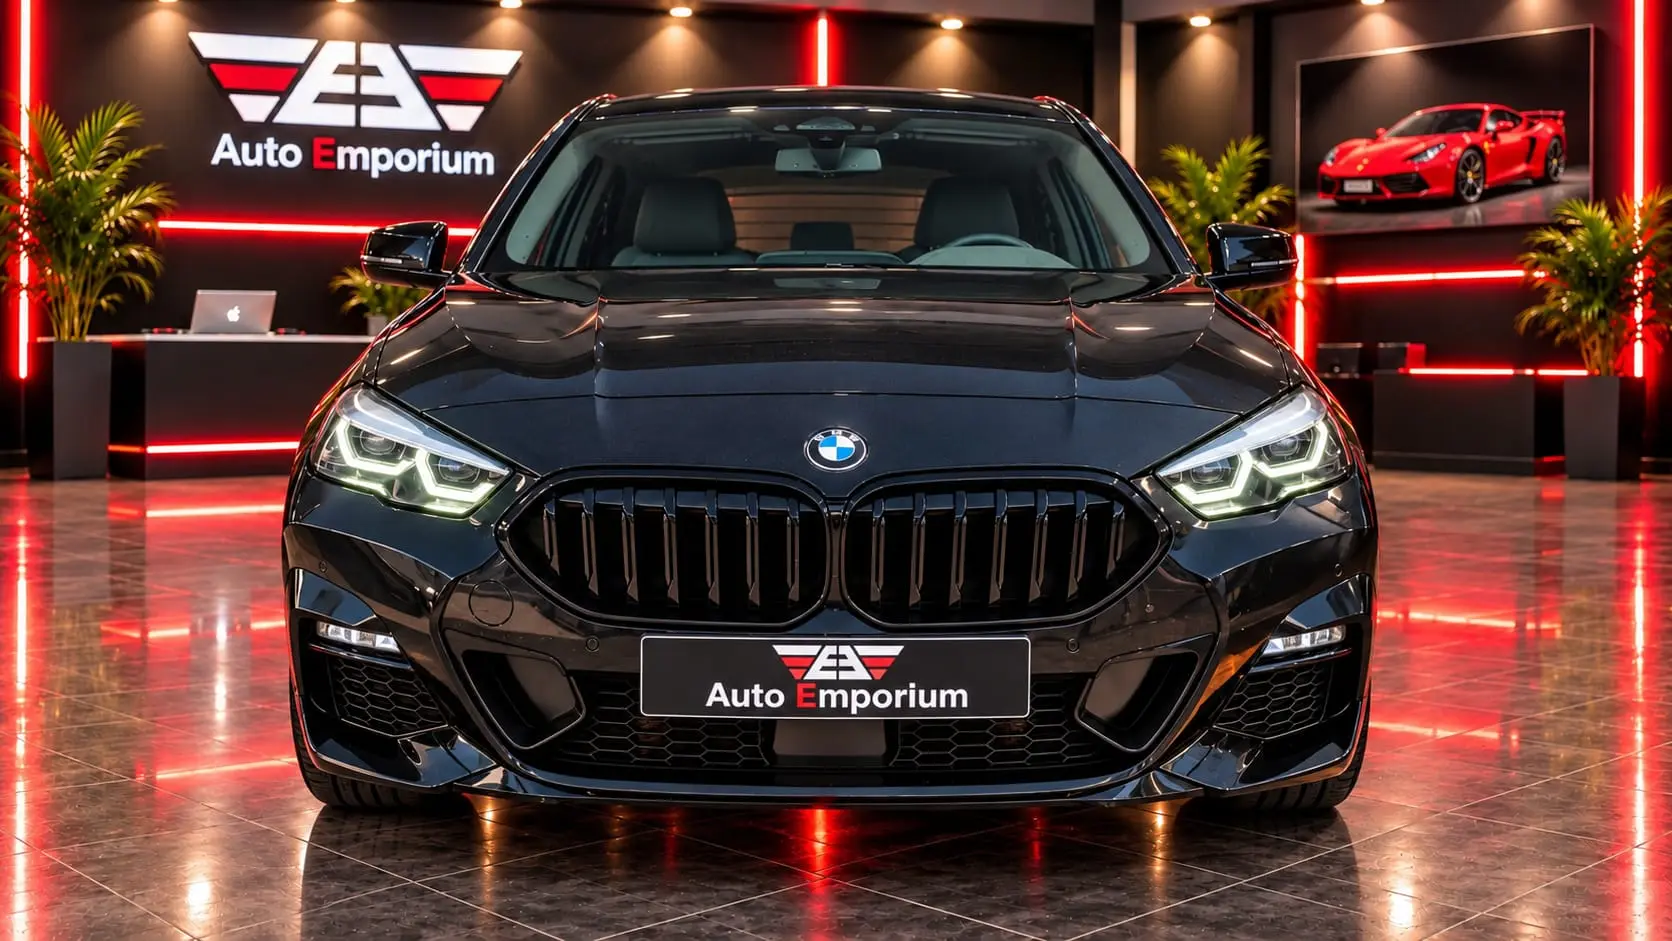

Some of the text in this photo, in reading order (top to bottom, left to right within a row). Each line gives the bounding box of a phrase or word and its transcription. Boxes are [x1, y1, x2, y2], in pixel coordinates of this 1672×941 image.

[211, 133, 495, 178] Auto Emporium
[705, 682, 968, 714] Auto Emporium
